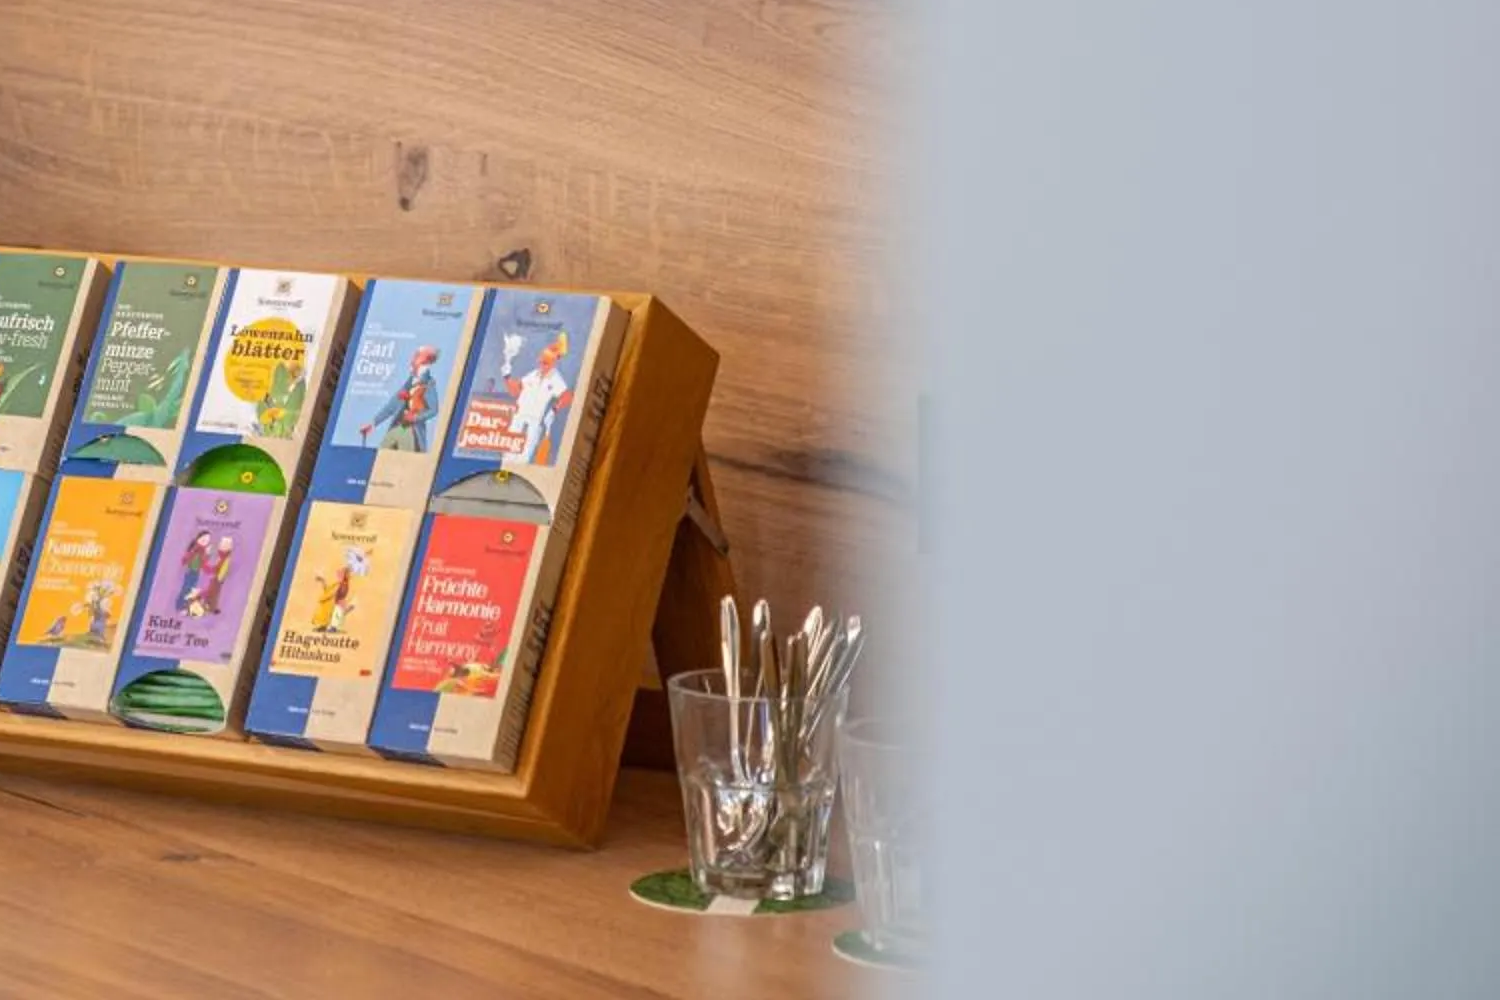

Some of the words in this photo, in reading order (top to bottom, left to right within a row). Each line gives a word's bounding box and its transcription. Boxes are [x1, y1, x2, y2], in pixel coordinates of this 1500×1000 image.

[111, 321, 171, 340] Pfeffer-
[105, 341, 154, 359] minze
[231, 339, 305, 361] blätter
[361, 340, 395, 358] Earl
[356, 358, 396, 381] Grey
[466, 411, 508, 429] Dar-
[458, 429, 525, 453] jeeling
[422, 575, 488, 599] Früchte
[417, 595, 502, 620] Harmonie
[283, 631, 360, 650] Hagebutte
[279, 645, 341, 663] Hibiskus
